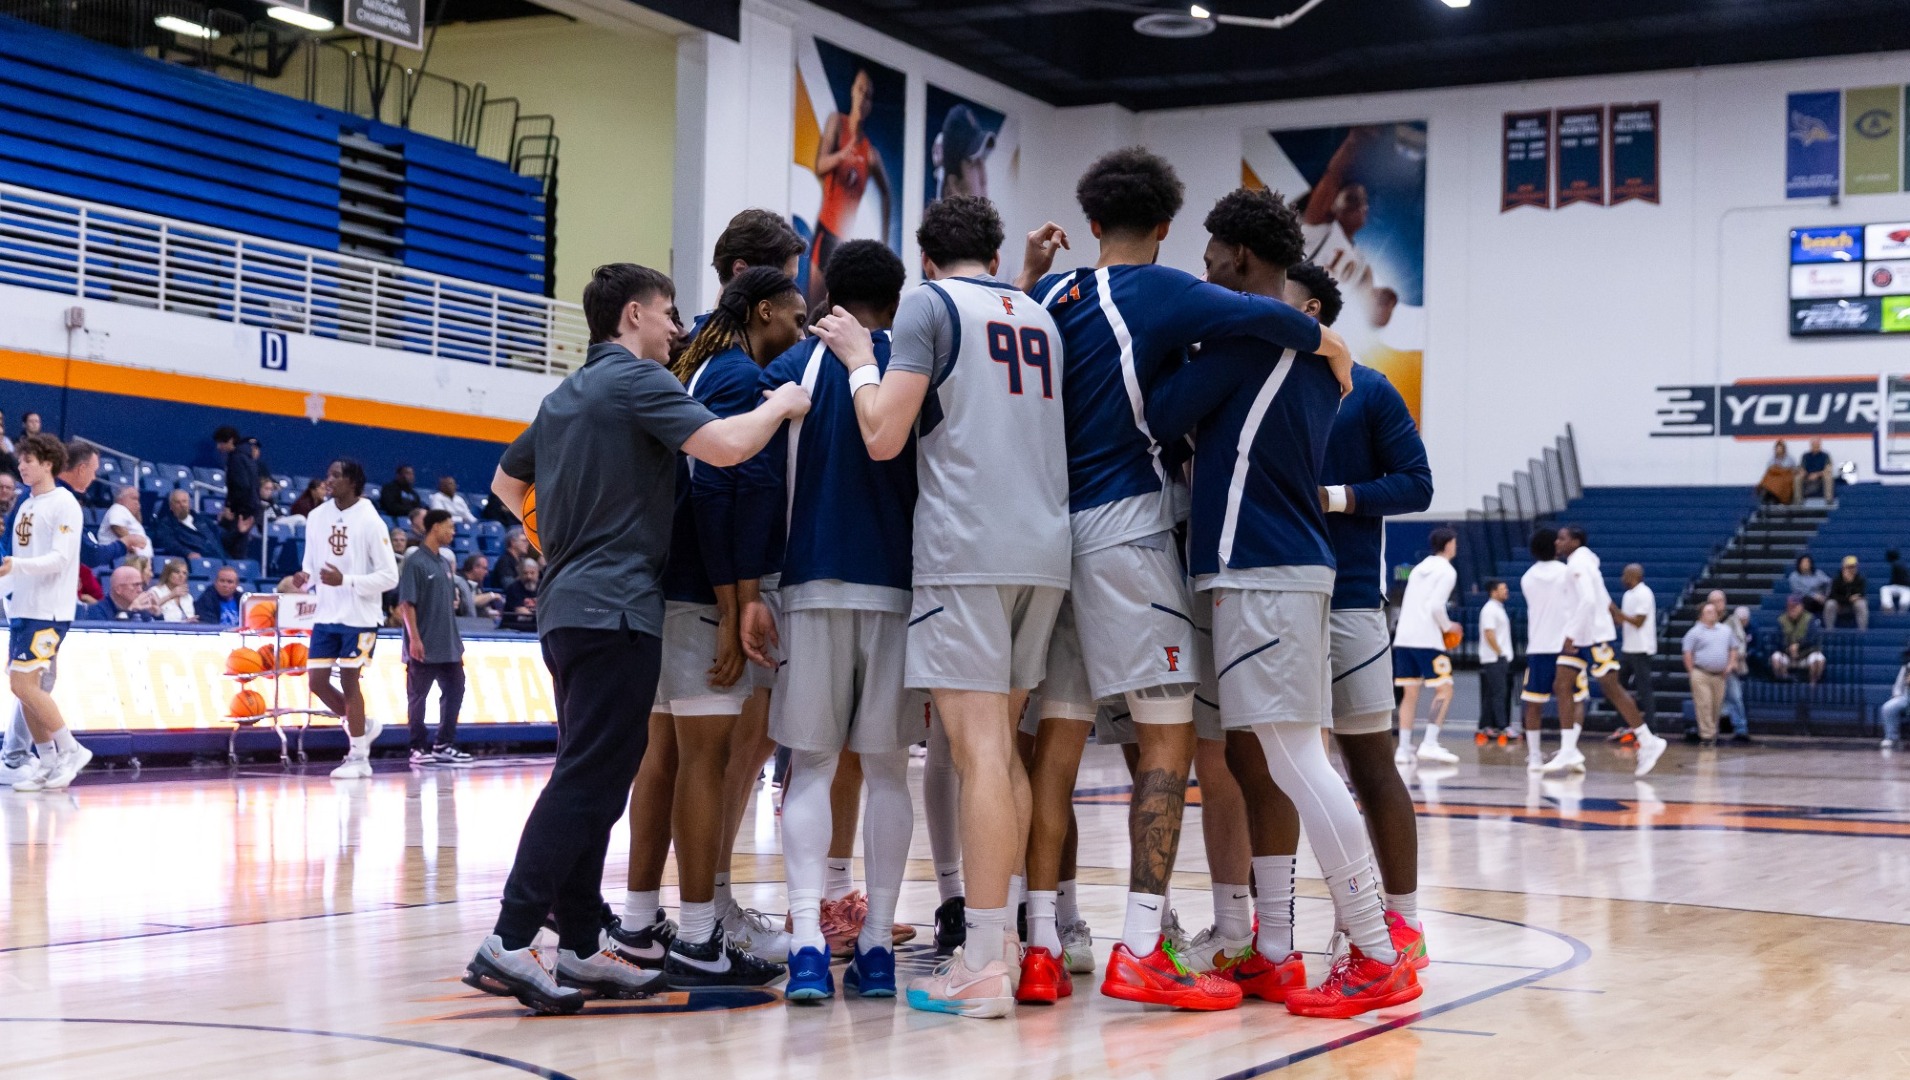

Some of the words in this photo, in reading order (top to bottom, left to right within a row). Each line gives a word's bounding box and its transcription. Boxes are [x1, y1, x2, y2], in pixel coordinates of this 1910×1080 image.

[1000, 296, 1015, 316] F
[266, 332, 283, 368] D
[987, 321, 1053, 399] 99
[1163, 646, 1180, 672] F
